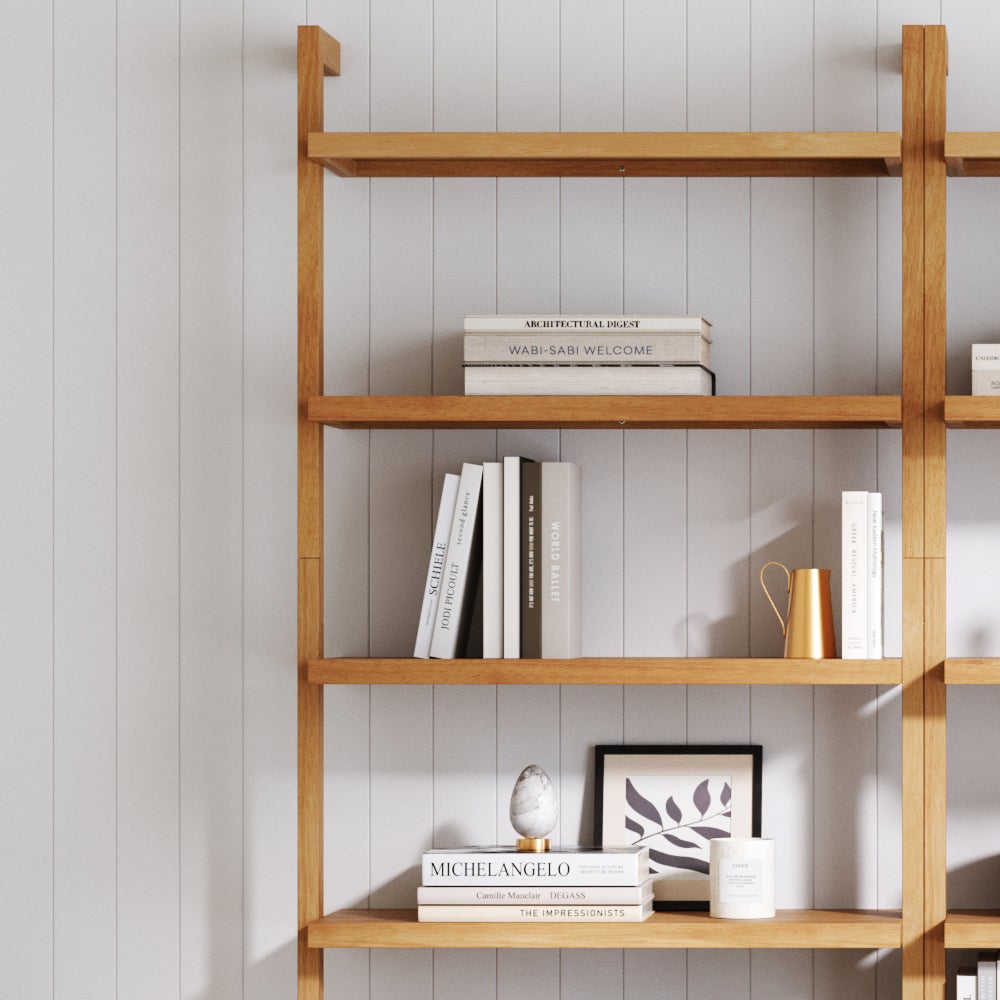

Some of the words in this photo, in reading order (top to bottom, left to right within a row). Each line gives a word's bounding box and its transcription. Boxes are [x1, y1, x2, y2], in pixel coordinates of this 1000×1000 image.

[524, 320, 605, 328] ARCHITECTURAL
[606, 320, 640, 328] DIGEST
[508, 345, 579, 356] WABI-SABI
[584, 345, 653, 356] WELCOME
[461, 491, 470, 517] glance
[457, 518, 466, 546] second
[551, 521, 560, 561] WORLD
[429, 542, 446, 596] SCHIELE
[444, 562, 459, 606] PICOULT
[551, 565, 560, 603] BALLET
[441, 607, 452, 630] JODI
[430, 861, 570, 878] MICHELANGELO
[476, 890, 506, 900] Camille
[507, 890, 541, 900] Mauclair
[550, 891, 586, 900] DEGASS
[520, 909, 540, 918] THE
[542, 909, 625, 918] IMPRESSIONISTS
